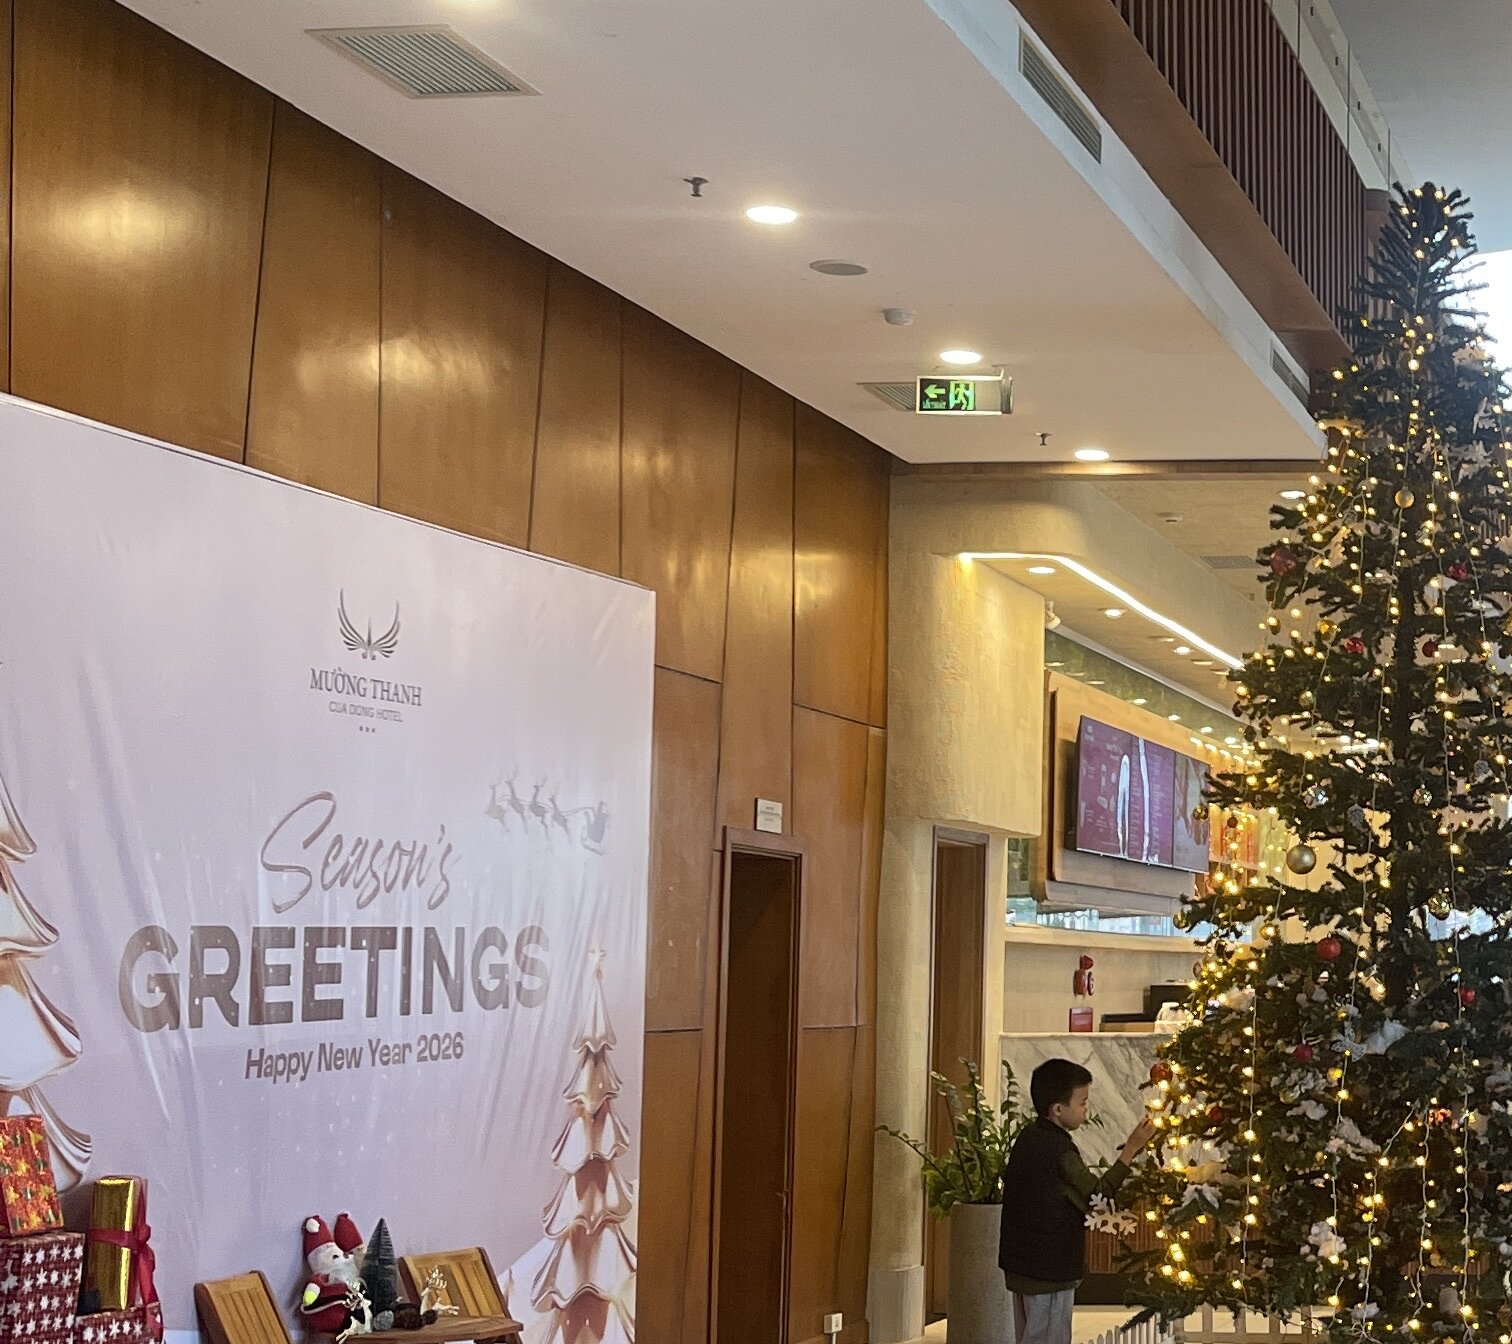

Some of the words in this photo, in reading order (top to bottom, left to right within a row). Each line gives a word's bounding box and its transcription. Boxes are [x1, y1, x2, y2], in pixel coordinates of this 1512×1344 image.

[309, 666, 367, 698] MƯỜNG
[370, 678, 422, 707] THANH
[261, 790, 455, 914] Season's
[118, 924, 550, 1033] GREETINGS
[245, 1048, 314, 1084] Happy
[317, 1042, 363, 1072] New
[368, 1038, 412, 1067] Year
[416, 1031, 464, 1063] 2026
